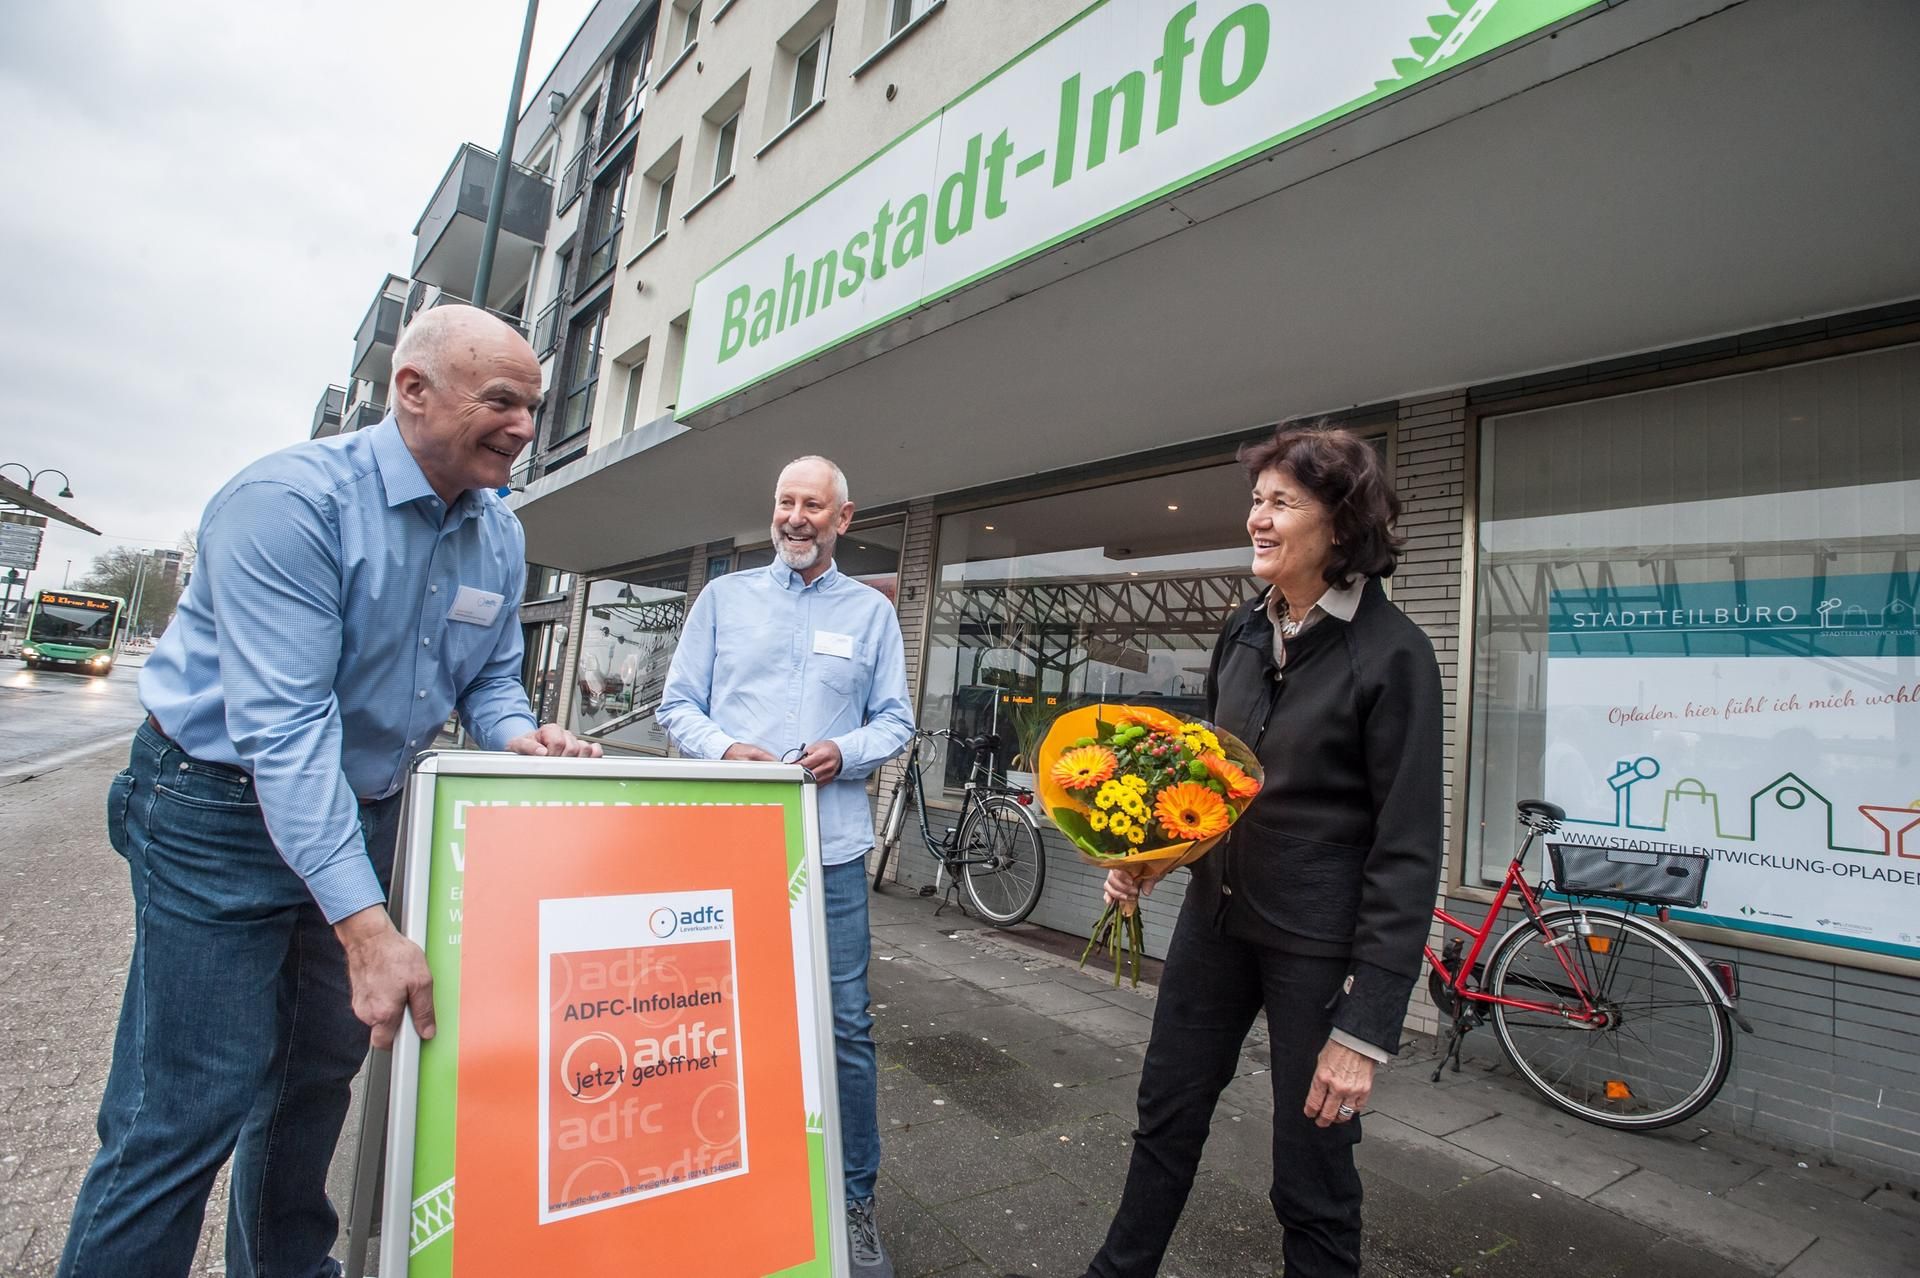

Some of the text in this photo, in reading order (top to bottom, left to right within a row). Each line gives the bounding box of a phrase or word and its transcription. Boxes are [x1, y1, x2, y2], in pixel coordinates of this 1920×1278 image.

[717, 1, 1271, 364] Bahnstadt-Info
[1572, 604, 1797, 628] STADTTEILBÜRO
[1685, 702, 1719, 717] hier
[1773, 693, 1801, 711] ich
[1808, 689, 1857, 709] mich
[1562, 831, 1920, 886] WWW.STADTTEILENTWICKLUNG-OPLADE
[680, 906, 724, 924] adfc
[579, 949, 678, 991] adfc
[564, 990, 722, 1022] ADFC-Infoladen
[633, 1021, 729, 1068] adfc
[572, 1051, 718, 1096] jetzt geöffnet
[558, 1097, 664, 1150] adfc
